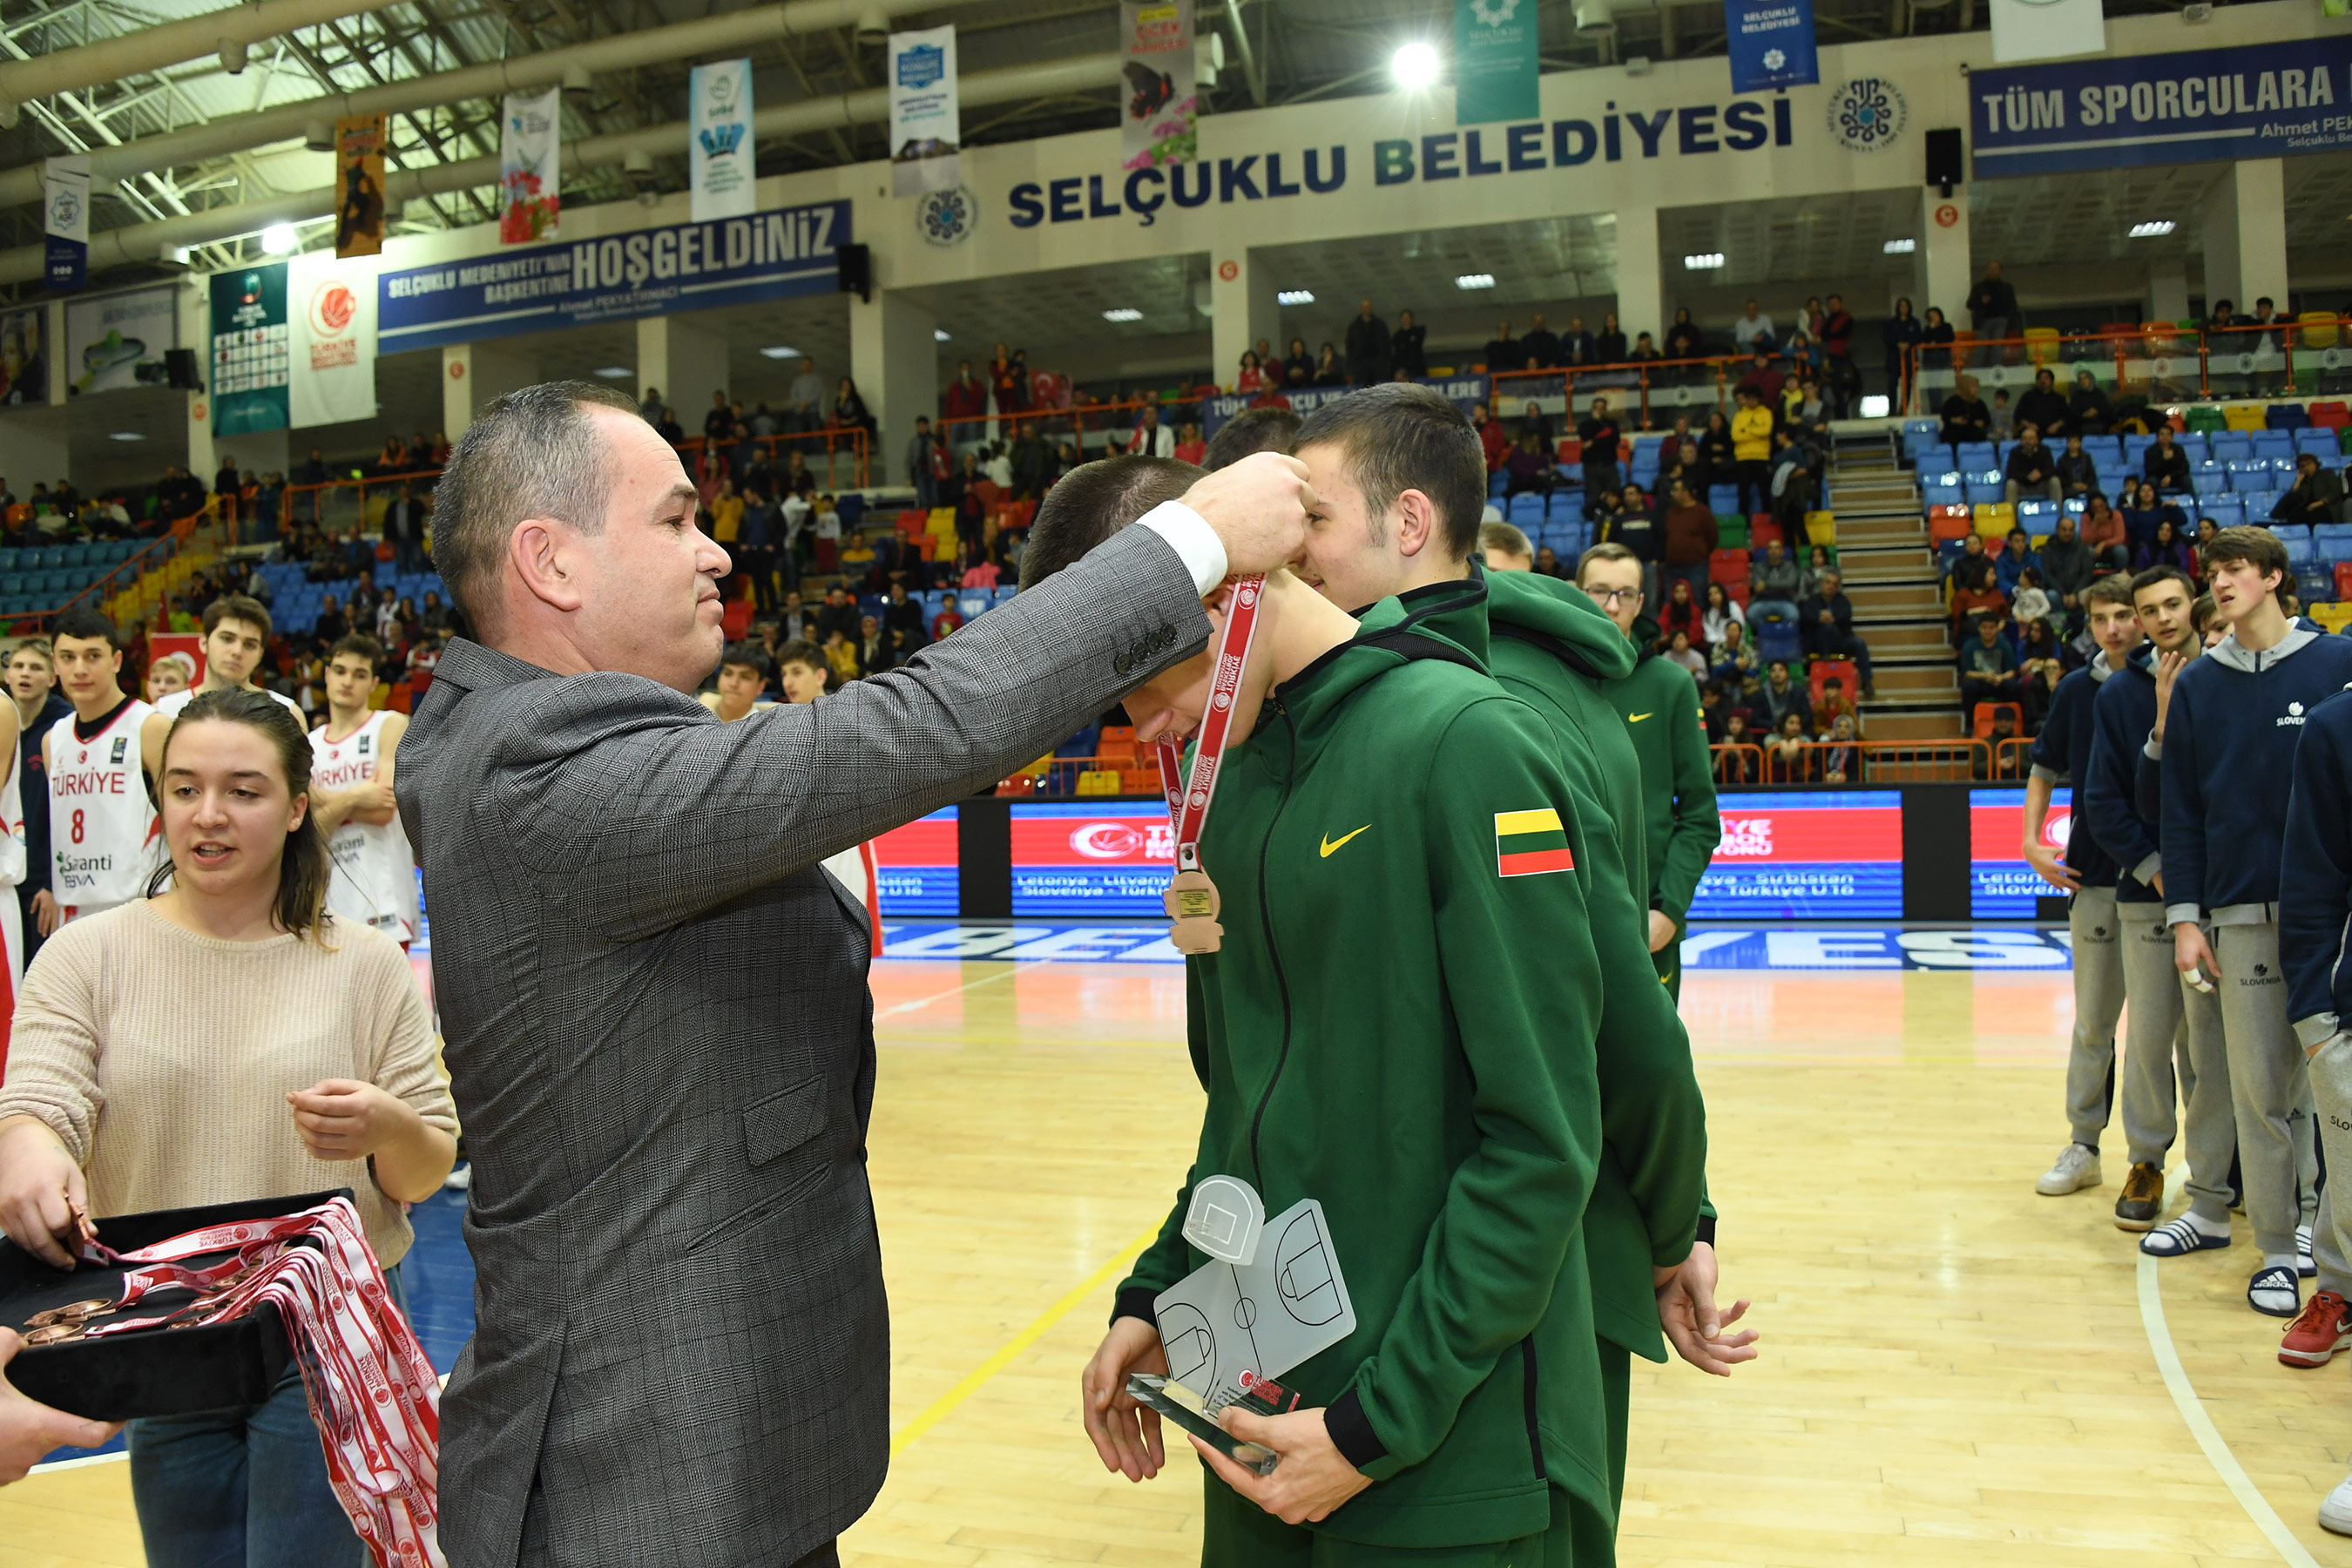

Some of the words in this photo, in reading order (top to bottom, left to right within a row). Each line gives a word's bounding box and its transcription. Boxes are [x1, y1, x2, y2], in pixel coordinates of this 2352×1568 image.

[1982, 85, 2065, 133] TÜM
[2080, 64, 2335, 127] SPORCULARA
[2261, 118, 2318, 138] Ahmet
[1008, 145, 1347, 226] SELÇUKLU
[1374, 87, 1793, 186] BELEDİYESİ
[2276, 716, 2307, 727] SLOVEN
[52, 767, 125, 798] TÜRKİYE
[71, 808, 84, 844] 8
[1017, 874, 1089, 888] Letonya
[1978, 872, 2044, 884] Leton
[1022, 885, 1105, 898] Slovenya
[1120, 884, 1171, 896] Türki
[1729, 884, 1807, 898] Türkiye
[355, 1355, 377, 1390] TÜRKİYE
